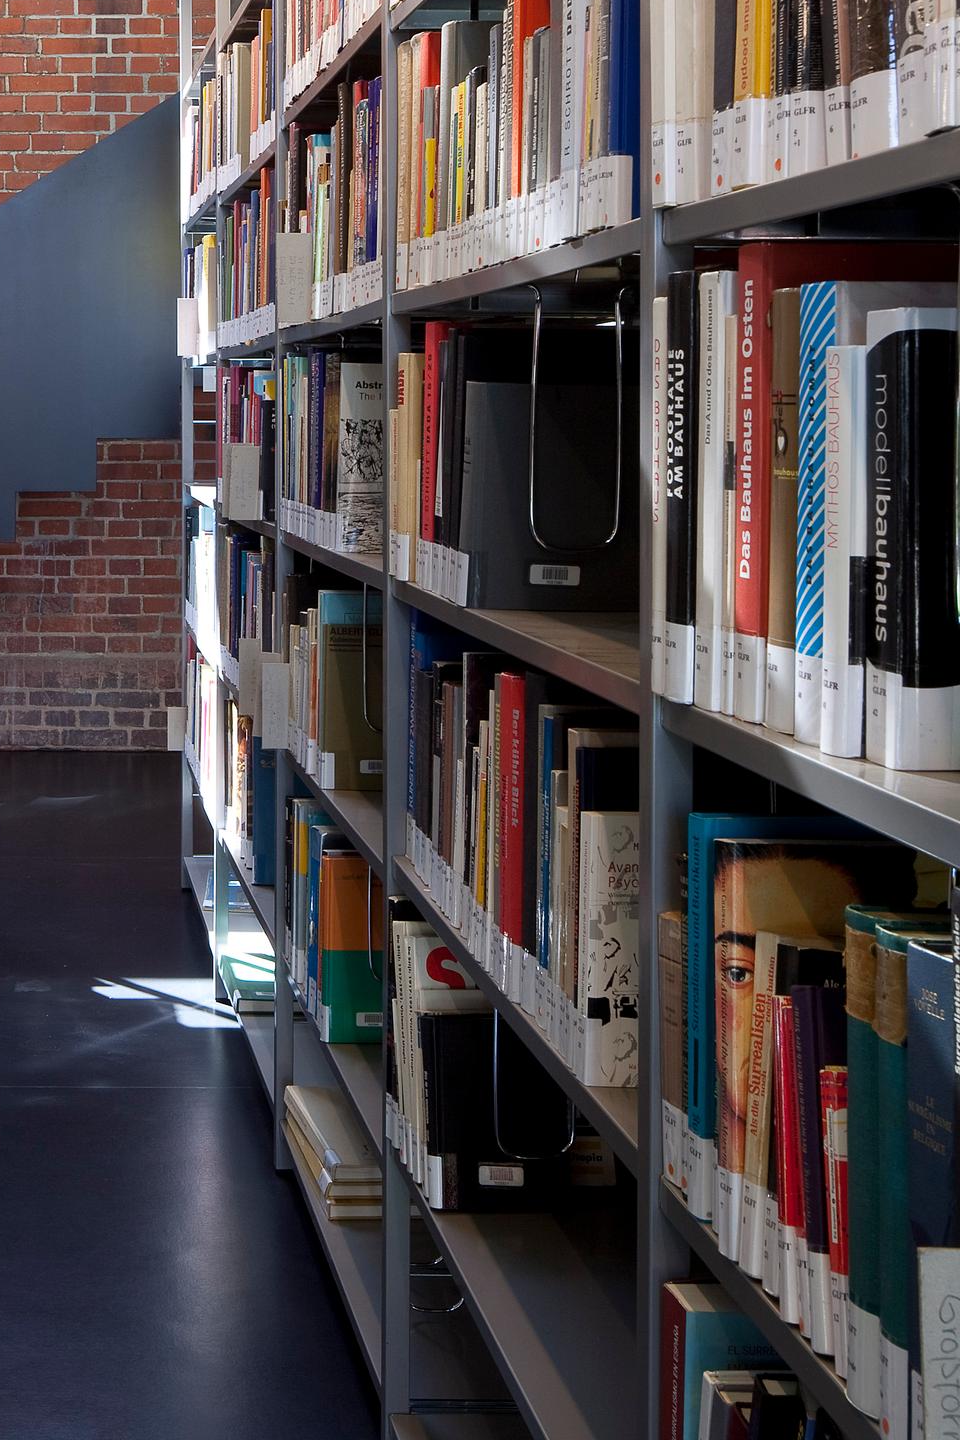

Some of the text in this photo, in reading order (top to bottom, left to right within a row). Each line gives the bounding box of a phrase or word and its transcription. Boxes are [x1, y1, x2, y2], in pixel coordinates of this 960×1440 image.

[564, 40, 573, 131] SCHROTT
[741, 37, 750, 91] people
[793, 106, 816, 117] GLFR
[828, 101, 851, 112] GLFR
[355, 381, 383, 389] Abstr
[359, 392, 377, 401] The
[667, 349, 675, 498] FOTOGRAFIE
[674, 348, 685, 499] AM BAUHAUS
[739, 279, 754, 580] Das Bauhaus im Osten
[652, 400, 660, 522] BAUHAUS
[827, 353, 840, 549] MYTHOS BAUHAUS
[807, 436, 815, 536] BAUHAUS
[875, 374, 891, 643] modellbauhaus
[494, 702, 502, 792] wirklichkeit
[511, 708, 520, 828] Der kühle Blick
[607, 862, 639, 873] Avan
[608, 876, 639, 891] Psyc
[691, 834, 700, 1033] Surrealismus und Buchkunst
[720, 940, 729, 982] Women
[767, 956, 776, 993] hatten
[720, 985, 729, 1022] Artists
[720, 1023, 729, 1046] and
[720, 1047, 729, 1064] the
[748, 992, 767, 1137] Als die Surrealisten
[743, 1345, 778, 1356] SURRE
